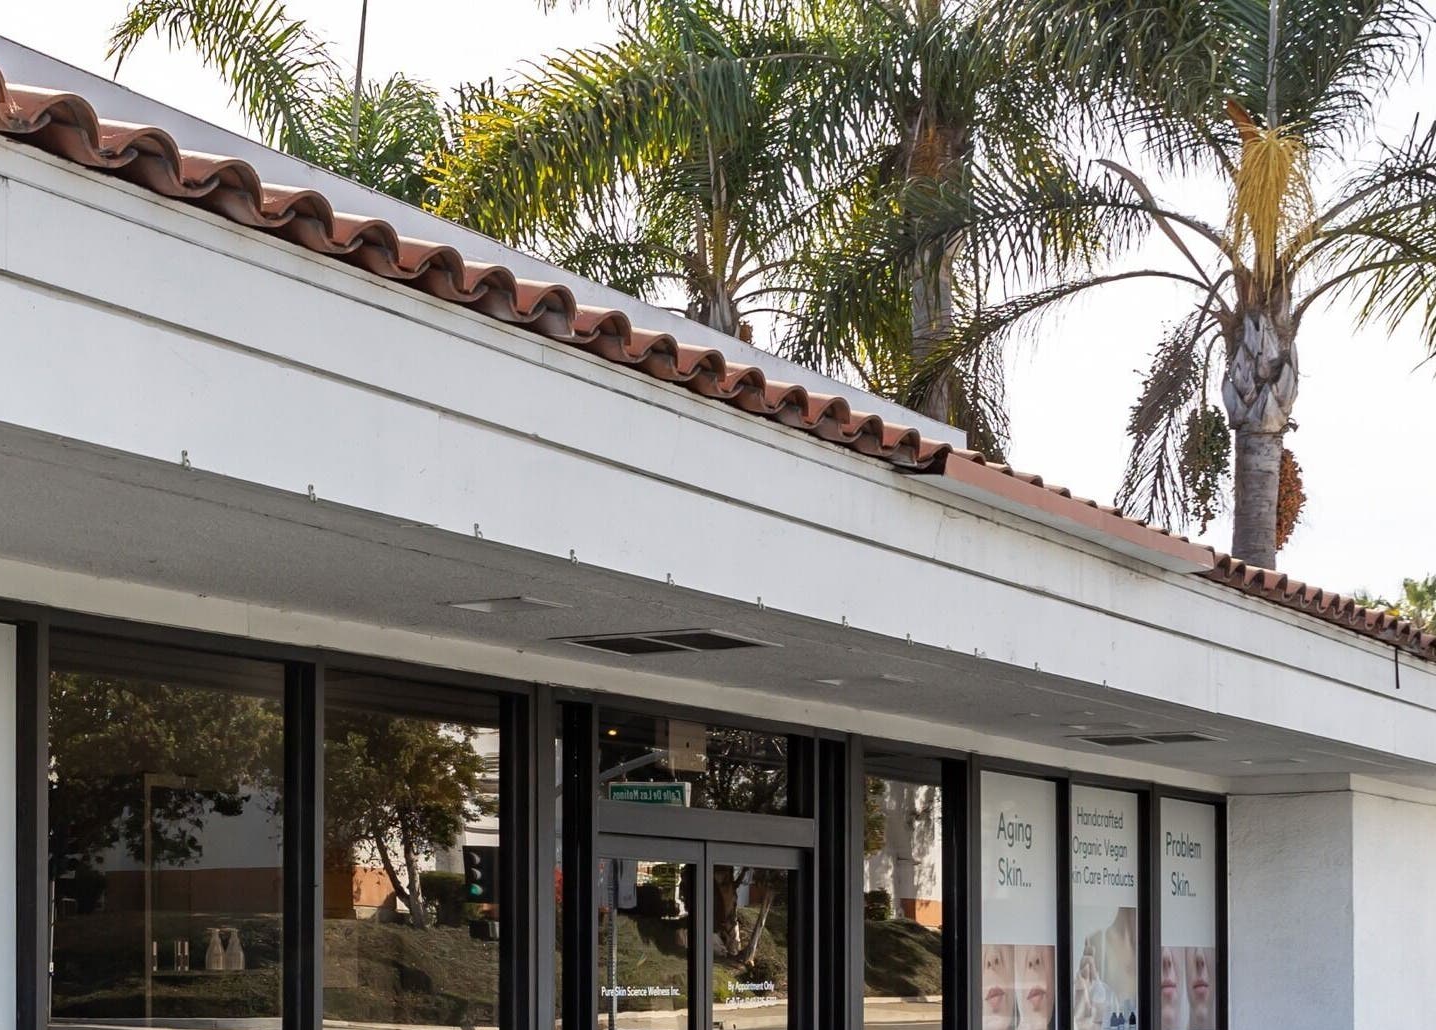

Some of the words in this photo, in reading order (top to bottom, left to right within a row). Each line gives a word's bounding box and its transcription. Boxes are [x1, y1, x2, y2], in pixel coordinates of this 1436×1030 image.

[1076, 806, 1124, 829] Handcrafted
[997, 812, 1032, 849] Aging
[1072, 835, 1102, 859] Organic
[1104, 839, 1127, 861] Vegan
[1166, 832, 1201, 860] Problem
[998, 857, 1032, 888] Skin...
[1084, 867, 1102, 885] Care
[1103, 868, 1135, 888] Products
[1171, 872, 1197, 897] Skin...
[601, 986, 614, 997] Pure
[614, 986, 626, 996] Skin
[627, 986, 647, 997] Science
[648, 986, 670, 997] Wellness
[728, 981, 735, 992] By
[735, 981, 763, 992] Appointment
[764, 980, 775, 992] Only
